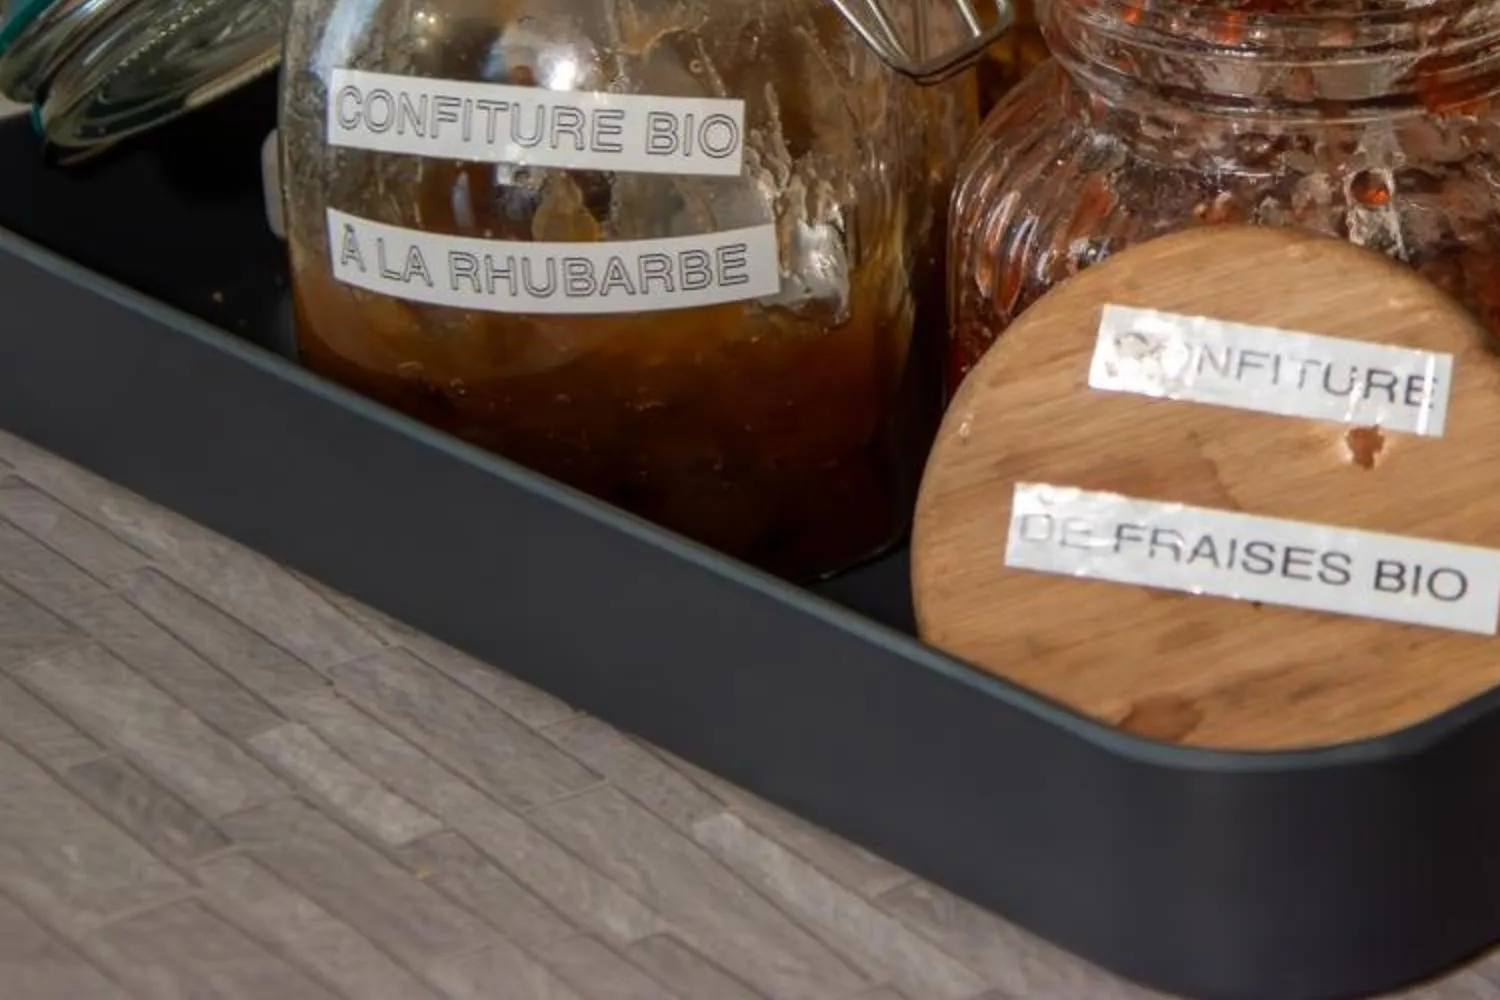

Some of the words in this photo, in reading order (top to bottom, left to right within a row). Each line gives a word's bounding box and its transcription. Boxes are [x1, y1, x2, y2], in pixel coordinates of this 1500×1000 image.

[336, 85, 625, 153] CONFITURE
[645, 110, 739, 160] BIO
[376, 237, 434, 288] LA
[448, 242, 750, 299] RHUBARBE
[1107, 331, 1438, 409] NFITURE
[1112, 522, 1352, 587] FRAISES
[1373, 559, 1469, 603] BIO
